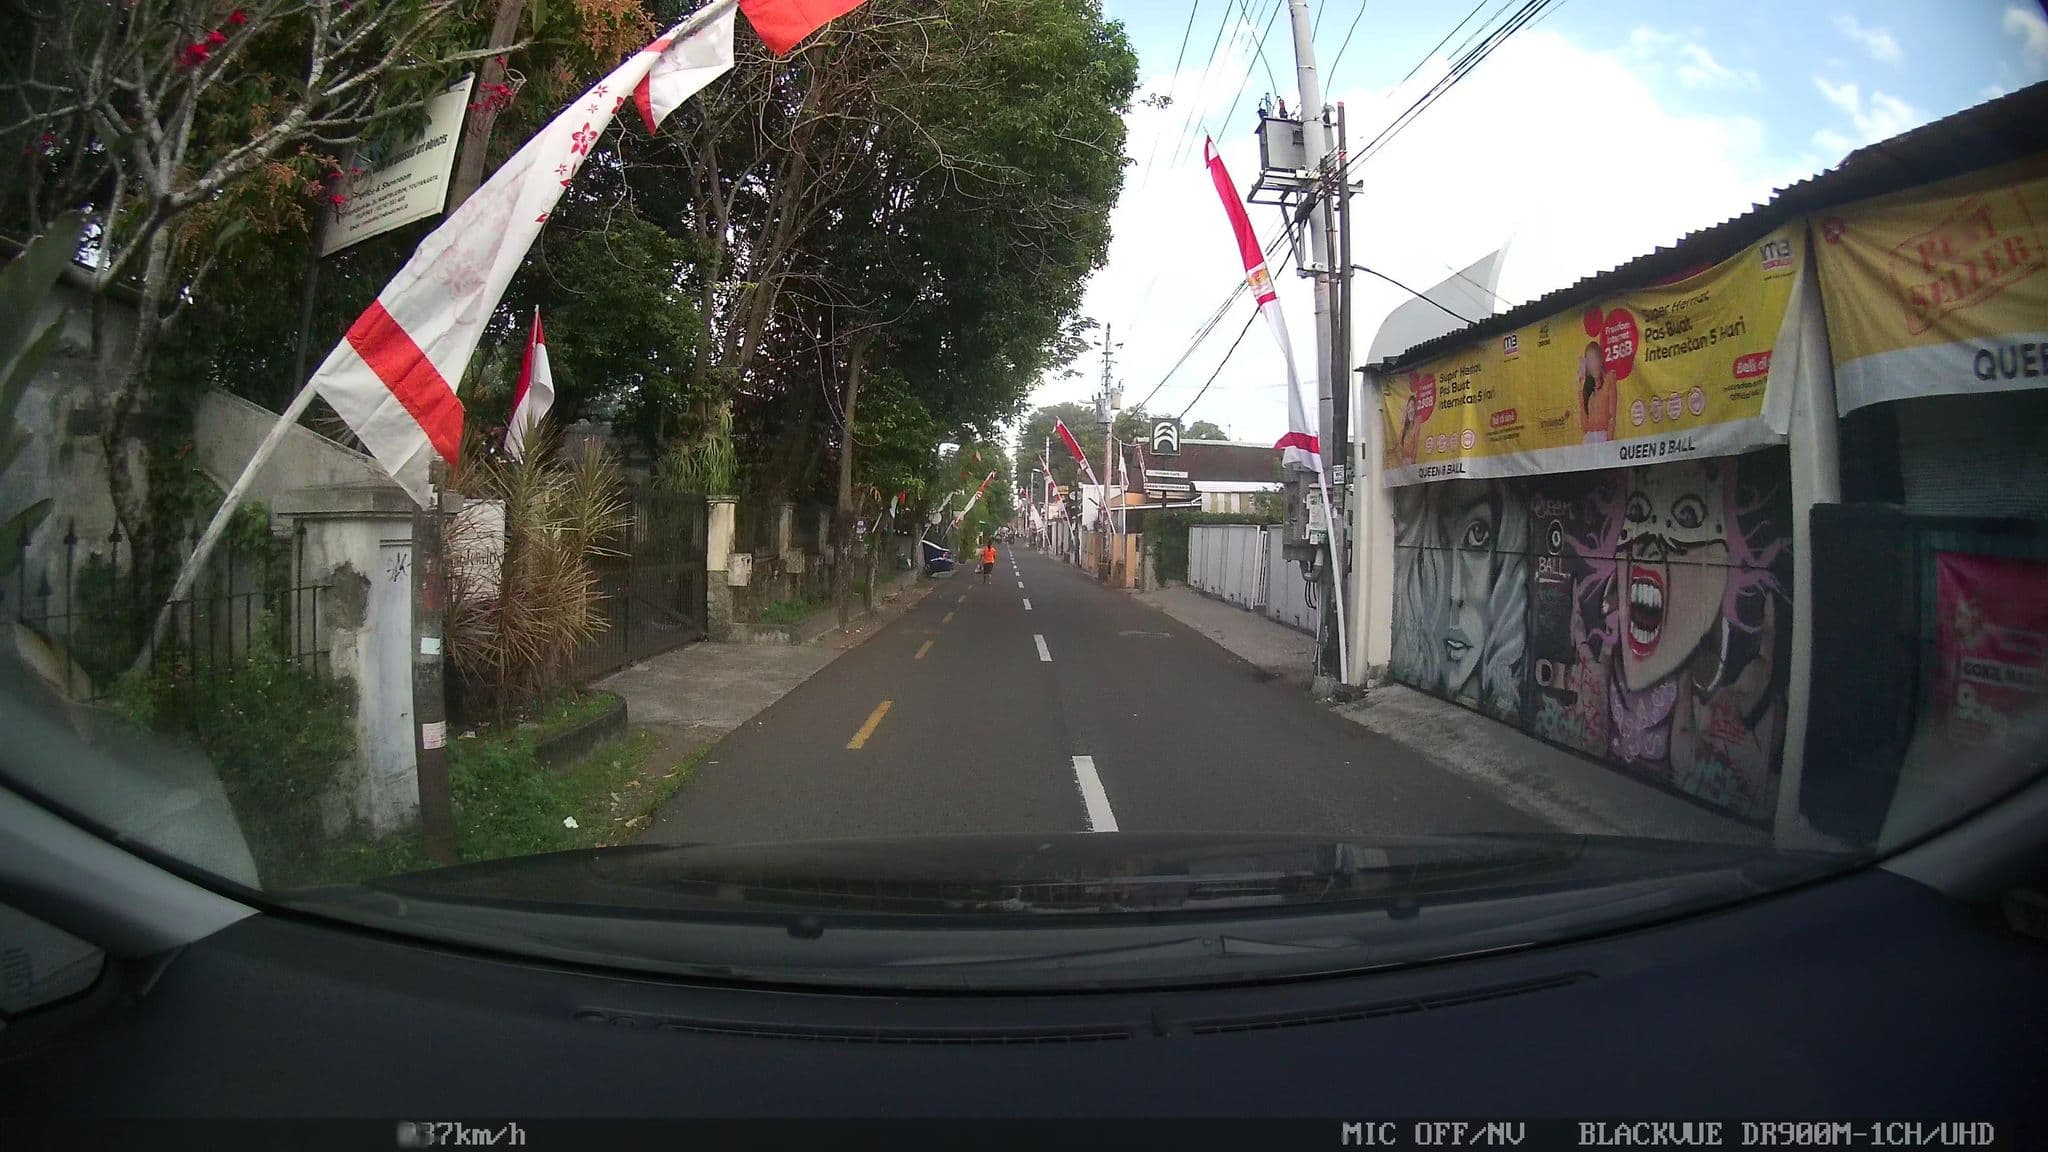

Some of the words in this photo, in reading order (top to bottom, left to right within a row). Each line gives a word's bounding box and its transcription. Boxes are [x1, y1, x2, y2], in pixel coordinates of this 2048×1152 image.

[1645, 327, 1666, 343] Pas
[1666, 317, 1693, 337] Buat
[1645, 333, 1708, 362] Internetan
[1710, 328, 1717, 345] 5
[1720, 316, 1746, 340] Hari
[1619, 442, 1657, 461] QUEEN
[1668, 436, 1696, 454] BALL
[1418, 465, 1441, 479] QUEEN
[1447, 462, 1466, 475] BALL
[1538, 556, 1566, 577] BALL
